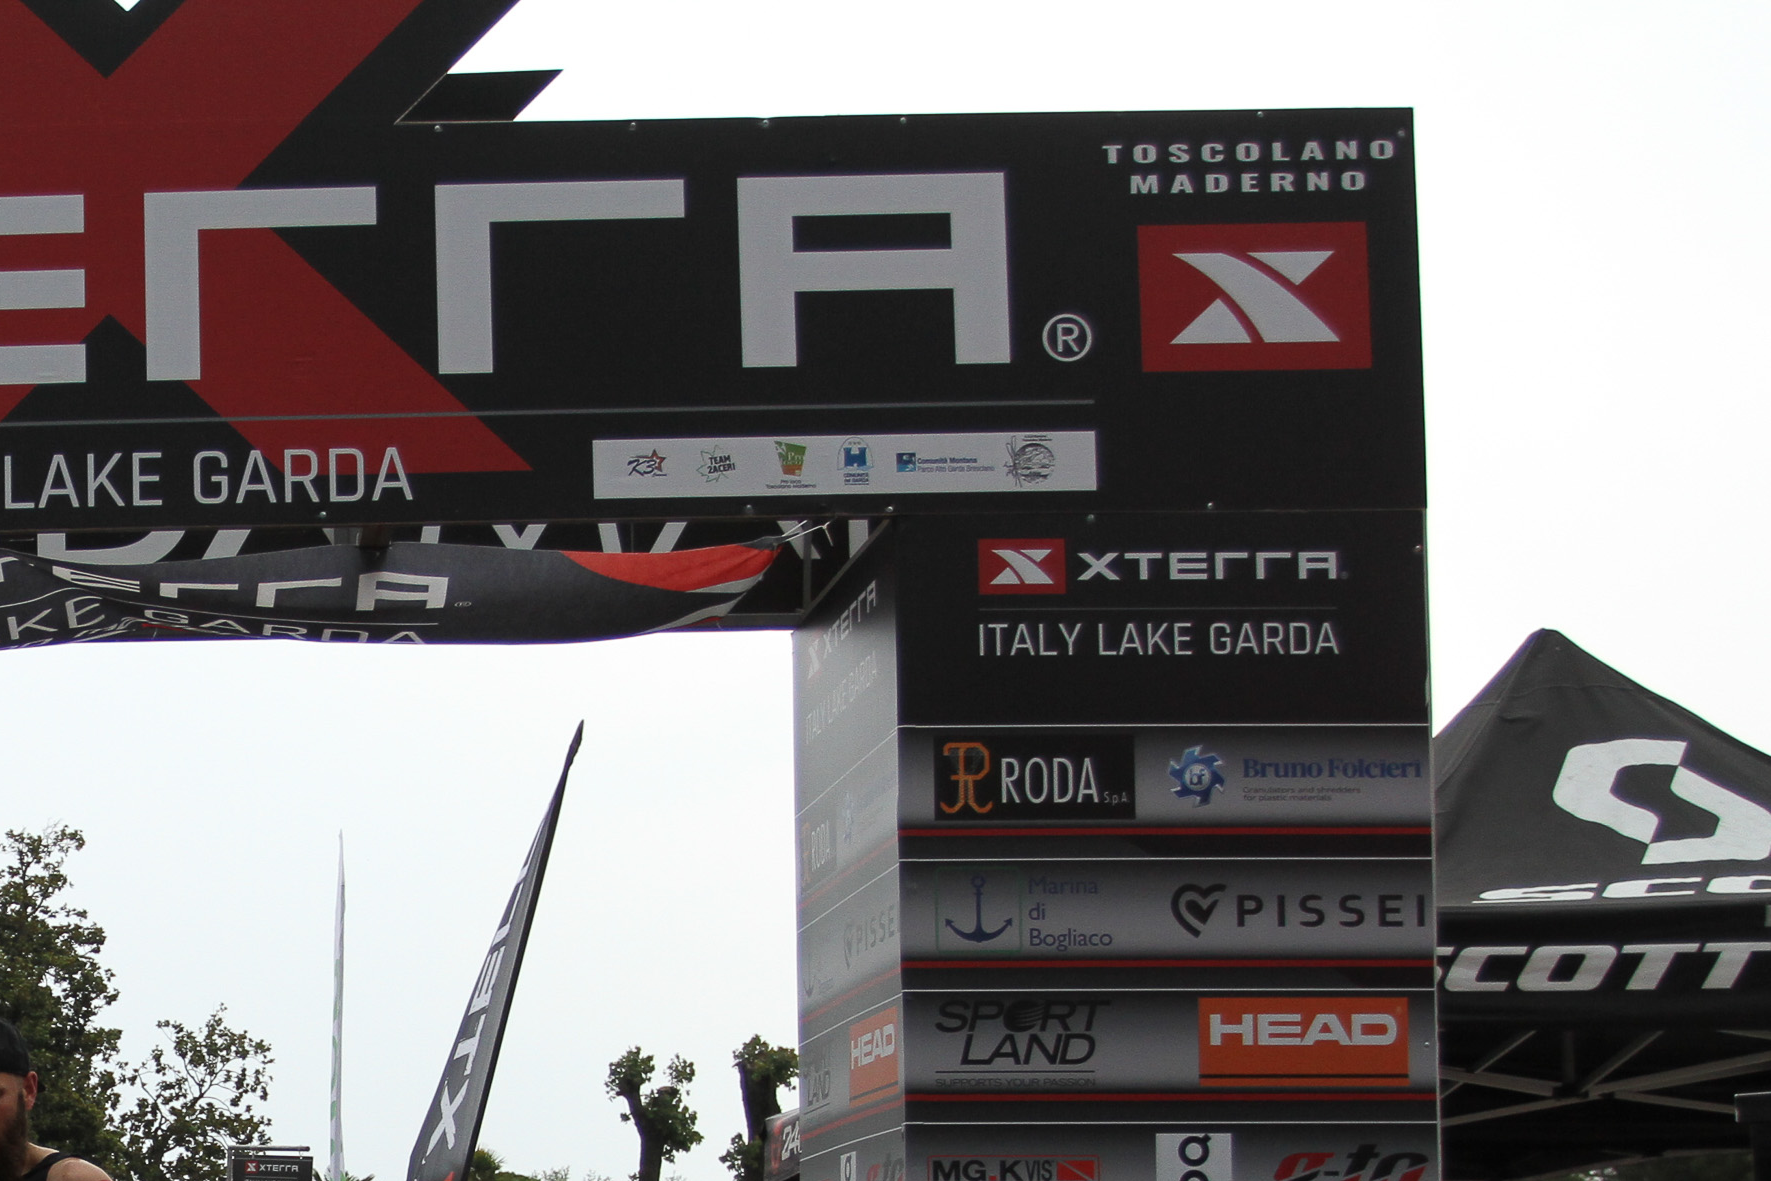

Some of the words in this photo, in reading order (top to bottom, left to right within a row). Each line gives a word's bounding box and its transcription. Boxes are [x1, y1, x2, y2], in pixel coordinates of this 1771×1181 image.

[1102, 139, 1396, 166] TOSCOLANO
[1130, 170, 1368, 195] MADERNO
[4, 451, 164, 510] LAKE
[193, 445, 415, 506] GARDA
[1077, 552, 1338, 581] XTERRA
[978, 622, 1082, 656] ITALY
[1098, 621, 1192, 656] LAKE
[1210, 620, 1339, 655] GARDA
[1001, 757, 1100, 805] RODA
[1243, 759, 1322, 779] Bruno
[1328, 758, 1423, 779] Folcieri
[1028, 876, 1098, 895] Marina
[1029, 903, 1046, 921] di
[1236, 894, 1427, 928] PISSEI
[1029, 928, 1113, 951] Bogliaco
[1436, 942, 1771, 992] COTT
[935, 1001, 1111, 1033] SPORT
[1209, 1013, 1398, 1047] HEAD
[960, 1033, 1096, 1066] LAND
[259, 1164, 299, 1173] XTERRA
